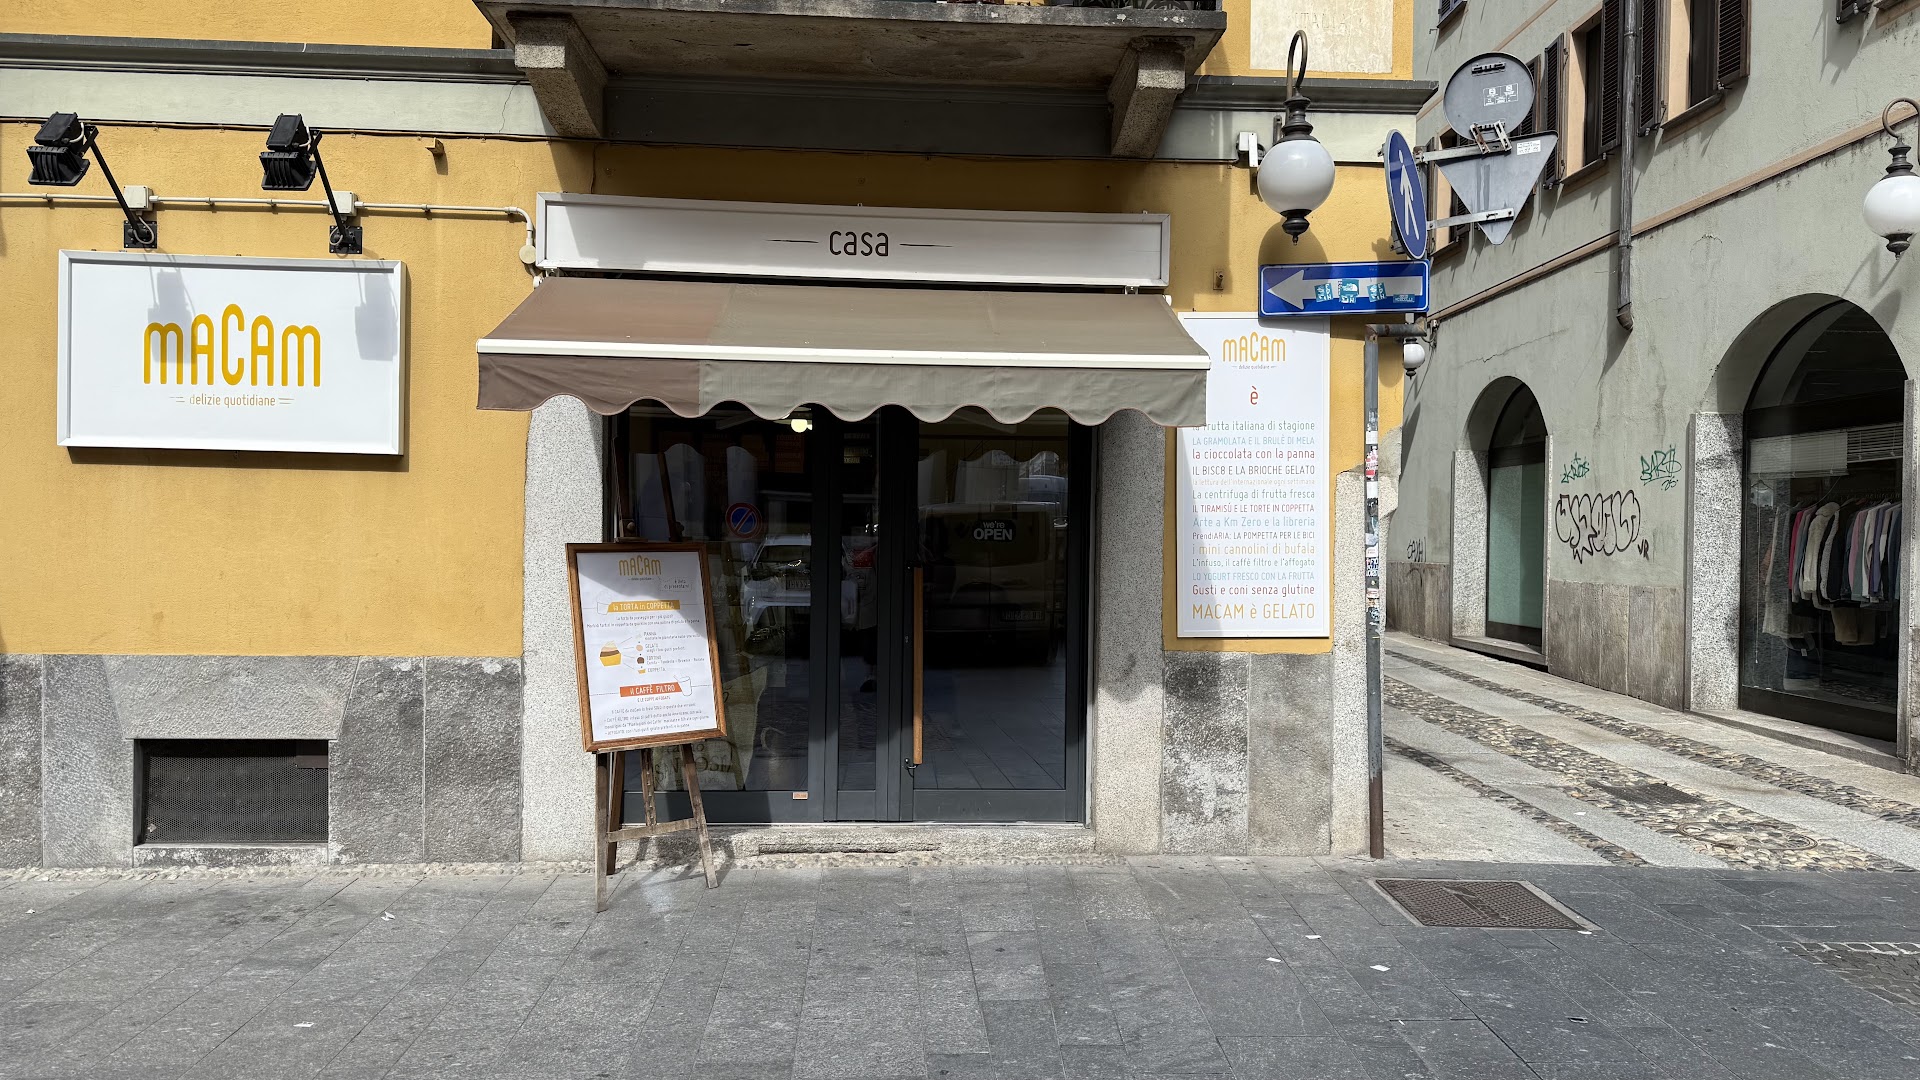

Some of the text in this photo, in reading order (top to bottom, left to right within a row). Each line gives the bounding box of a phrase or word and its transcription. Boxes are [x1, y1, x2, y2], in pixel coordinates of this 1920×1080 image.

[829, 230, 889, 258] casa
[190, 394, 276, 408] delizie quotidiane
[1250, 386, 1259, 405] è
[1232, 421, 1264, 430] italiana
[1268, 421, 1276, 430] di
[1279, 421, 1315, 434] stagione
[1193, 437, 1201, 445] LA
[1204, 437, 1246, 445] GRAMOLATA
[1248, 437, 1253, 445] E
[1255, 437, 1260, 445] IL
[1287, 437, 1294, 445] DI
[1296, 437, 1315, 445] MELA
[1193, 448, 1315, 460] la cioccolata con la panna
[1193, 466, 1199, 475] IL
[1229, 466, 1233, 475] E
[1236, 466, 1245, 475] LA
[1249, 466, 1282, 475] BRIOCHE
[1285, 466, 1315, 475] GELATO
[1193, 490, 1315, 501] La centrifuga di frutta fresca
[1193, 504, 1198, 512] IL
[1234, 504, 1238, 512] E
[1240, 504, 1247, 512] LE
[1250, 504, 1270, 512] TORTE
[1272, 504, 1279, 512] IN
[1282, 504, 1314, 512] COPPETTA
[1193, 518, 1213, 527] Arte
[1224, 518, 1238, 527] Km
[1241, 518, 1261, 527] Zero
[1272, 518, 1280, 527] la
[1283, 518, 1315, 527] libreria
[973, 527, 1013, 541] OPEN
[1199, 544, 1220, 554] mini
[1224, 544, 1269, 554] cannolini
[1272, 544, 1281, 554] di
[1284, 544, 1315, 554] bufala
[1226, 559, 1230, 567] il
[1253, 559, 1272, 567] filtro
[1280, 559, 1315, 568] l'affogato
[1192, 572, 1314, 580] LO YOGURT FRESCO CON LA FRUTTA
[1192, 585, 1217, 595] Gusti
[1229, 585, 1248, 595] coni
[1282, 585, 1315, 597] glutine
[1192, 604, 1315, 619] MACAM è GELATO
[636, 684, 653, 694] CAFFÈ
